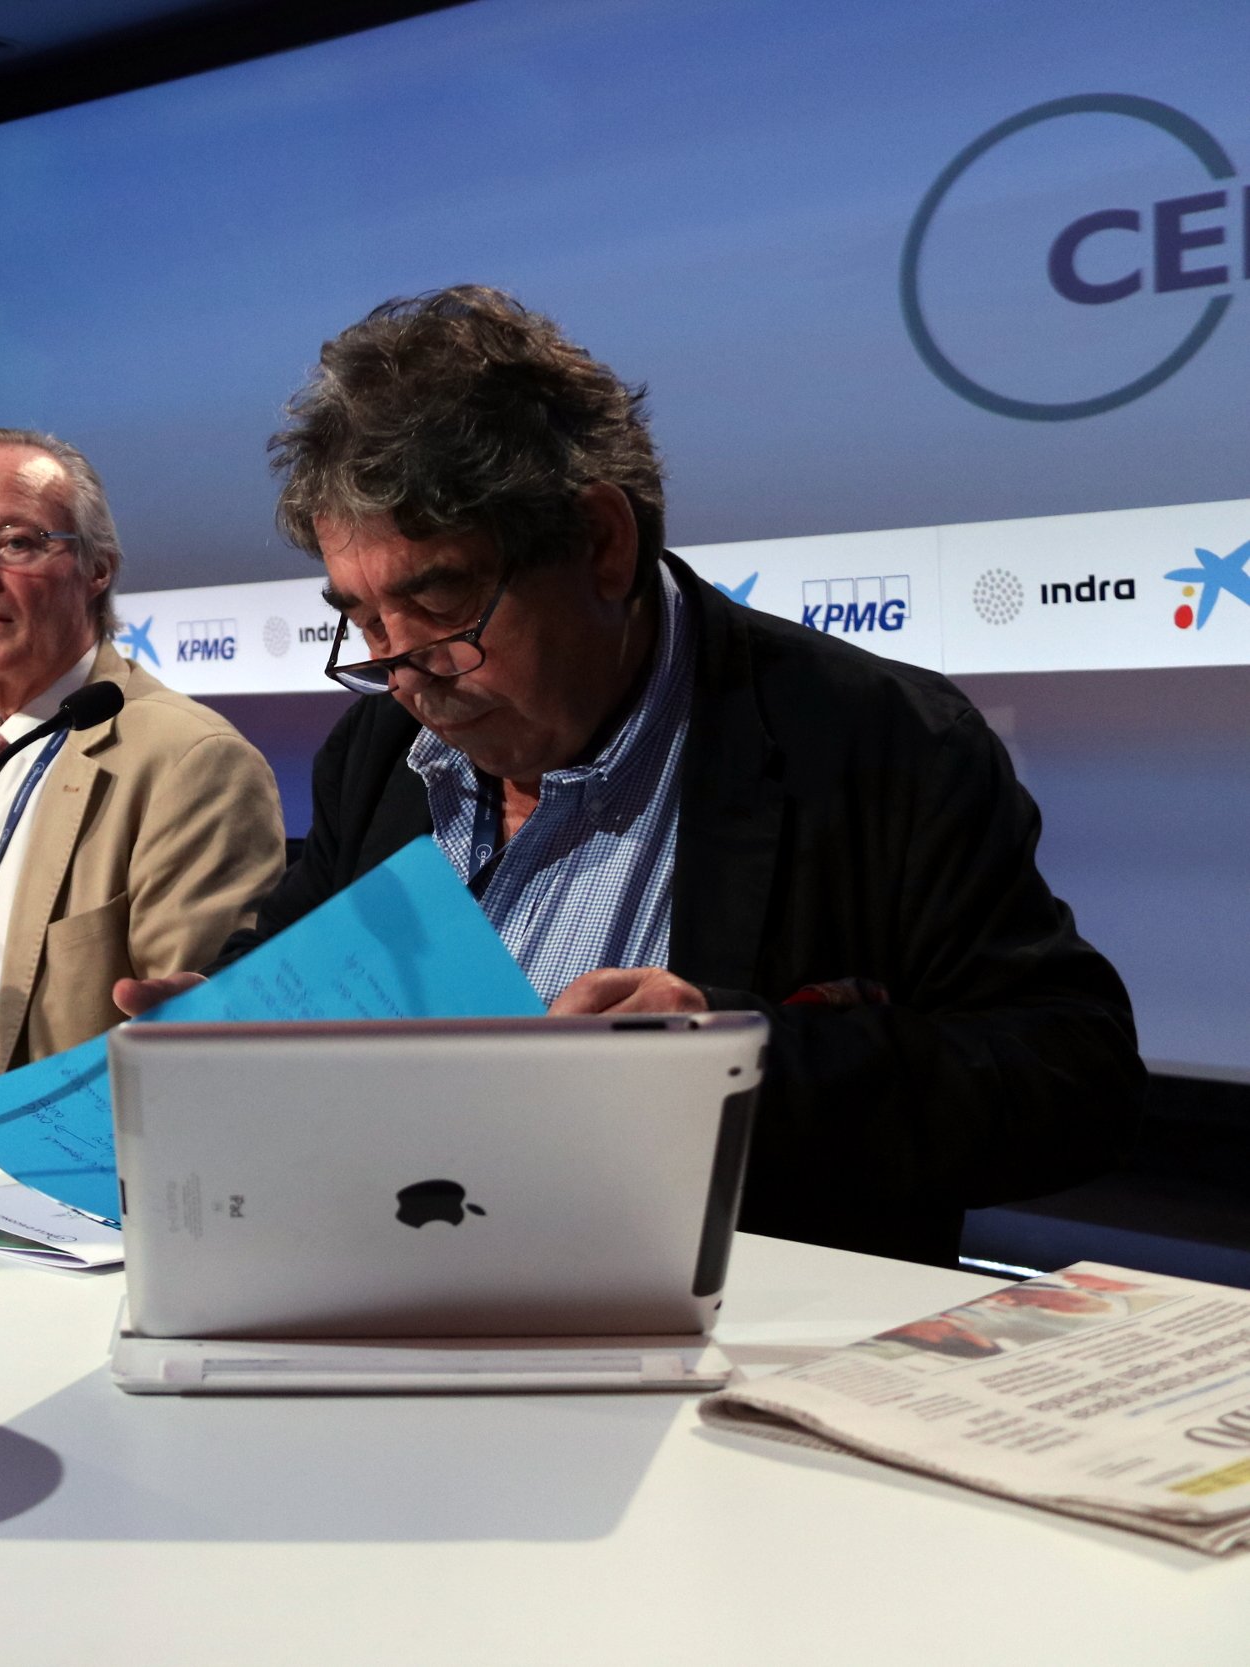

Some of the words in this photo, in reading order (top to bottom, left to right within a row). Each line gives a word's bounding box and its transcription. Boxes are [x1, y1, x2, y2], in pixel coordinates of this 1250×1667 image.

[1047, 185, 1250, 306] CE
[1041, 574, 1135, 605] indra
[801, 598, 906, 633] KPMG
[176, 636, 235, 662] KPMG
